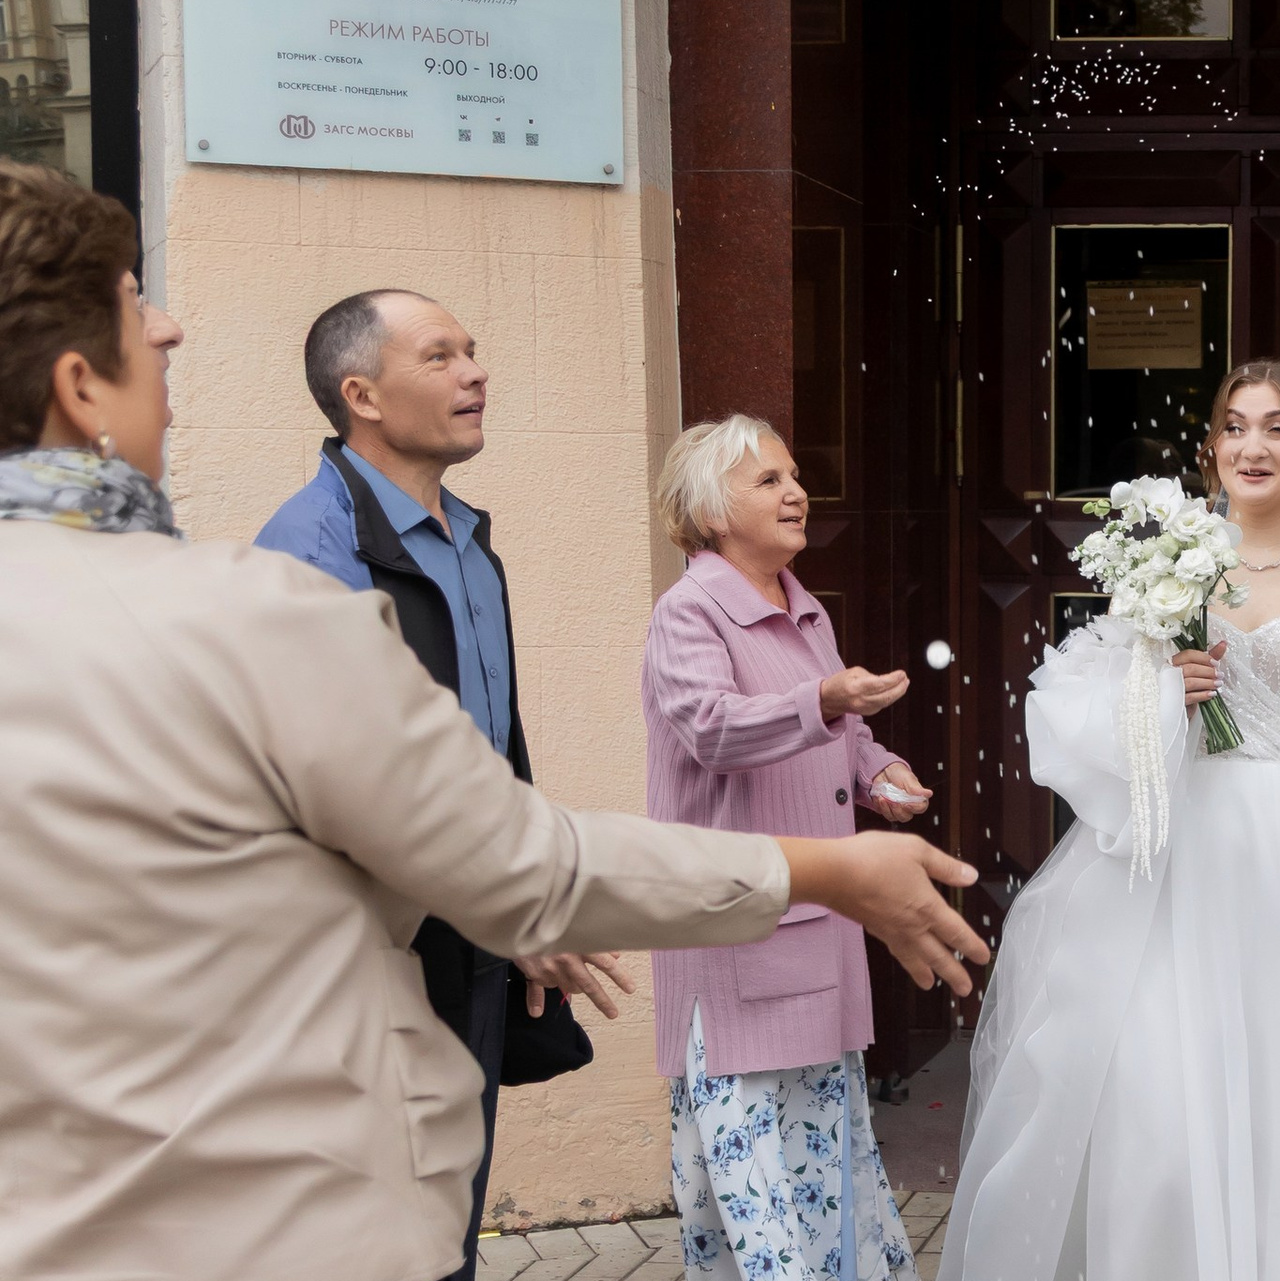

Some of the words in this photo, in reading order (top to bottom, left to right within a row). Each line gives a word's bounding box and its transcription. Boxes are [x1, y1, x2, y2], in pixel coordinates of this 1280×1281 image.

[329, 19, 405, 40] РЕЖИМ
[412, 25, 489, 47] РАБОТЫ
[277, 51, 317, 61] ВТОРНИК
[324, 55, 363, 65] СУББОТА
[424, 57, 468, 76] 9:00
[489, 62, 538, 81] 18:00
[277, 81, 338, 93] ВОСКРЕСЕНЬЕ
[344, 86, 408, 97] ПОНЕДЕЛЬНИК
[456, 94, 505, 104] ВЫХОДНОЙ
[323, 124, 355, 135] ЗАГС
[357, 125, 414, 138] МОСКВЫ
